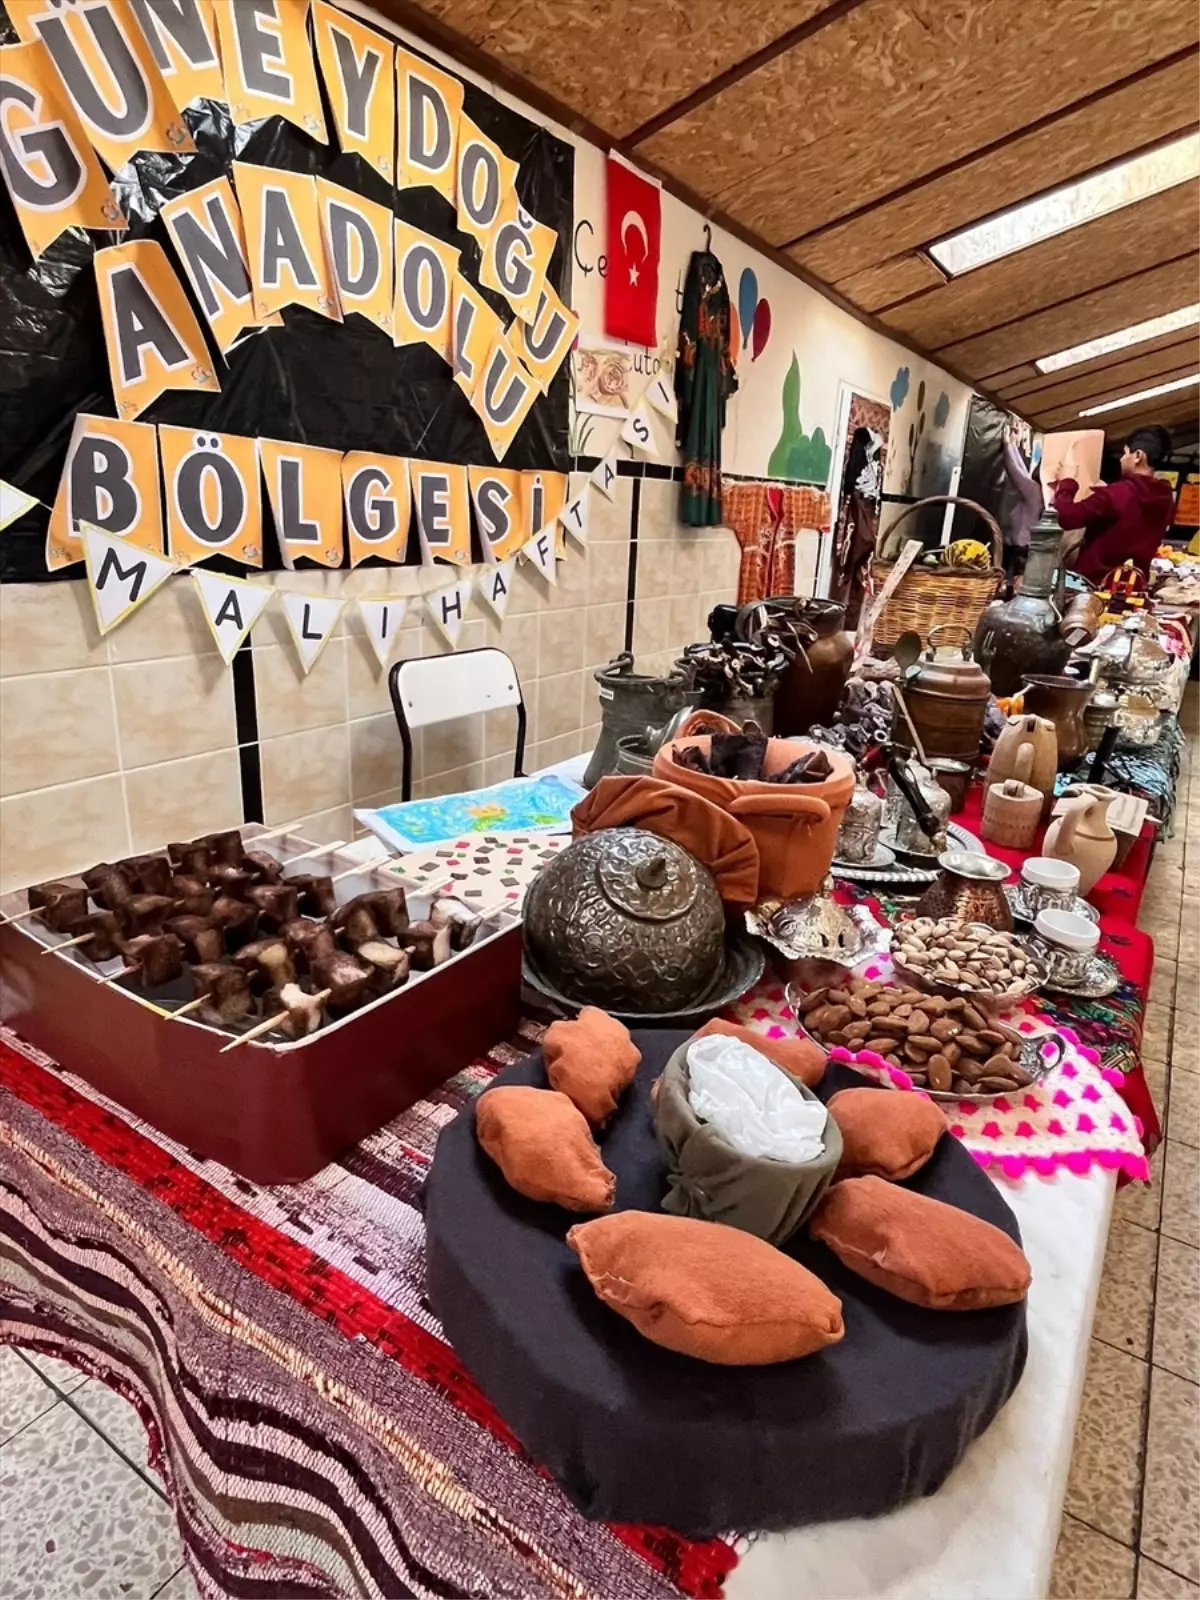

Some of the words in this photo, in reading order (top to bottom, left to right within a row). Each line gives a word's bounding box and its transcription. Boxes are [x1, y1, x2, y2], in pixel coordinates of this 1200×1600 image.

[0, 0, 568, 362] GÜNEYDOĞU
[107, 184, 528, 427] ANADOLU
[67, 431, 546, 545] BÖLGESİ
